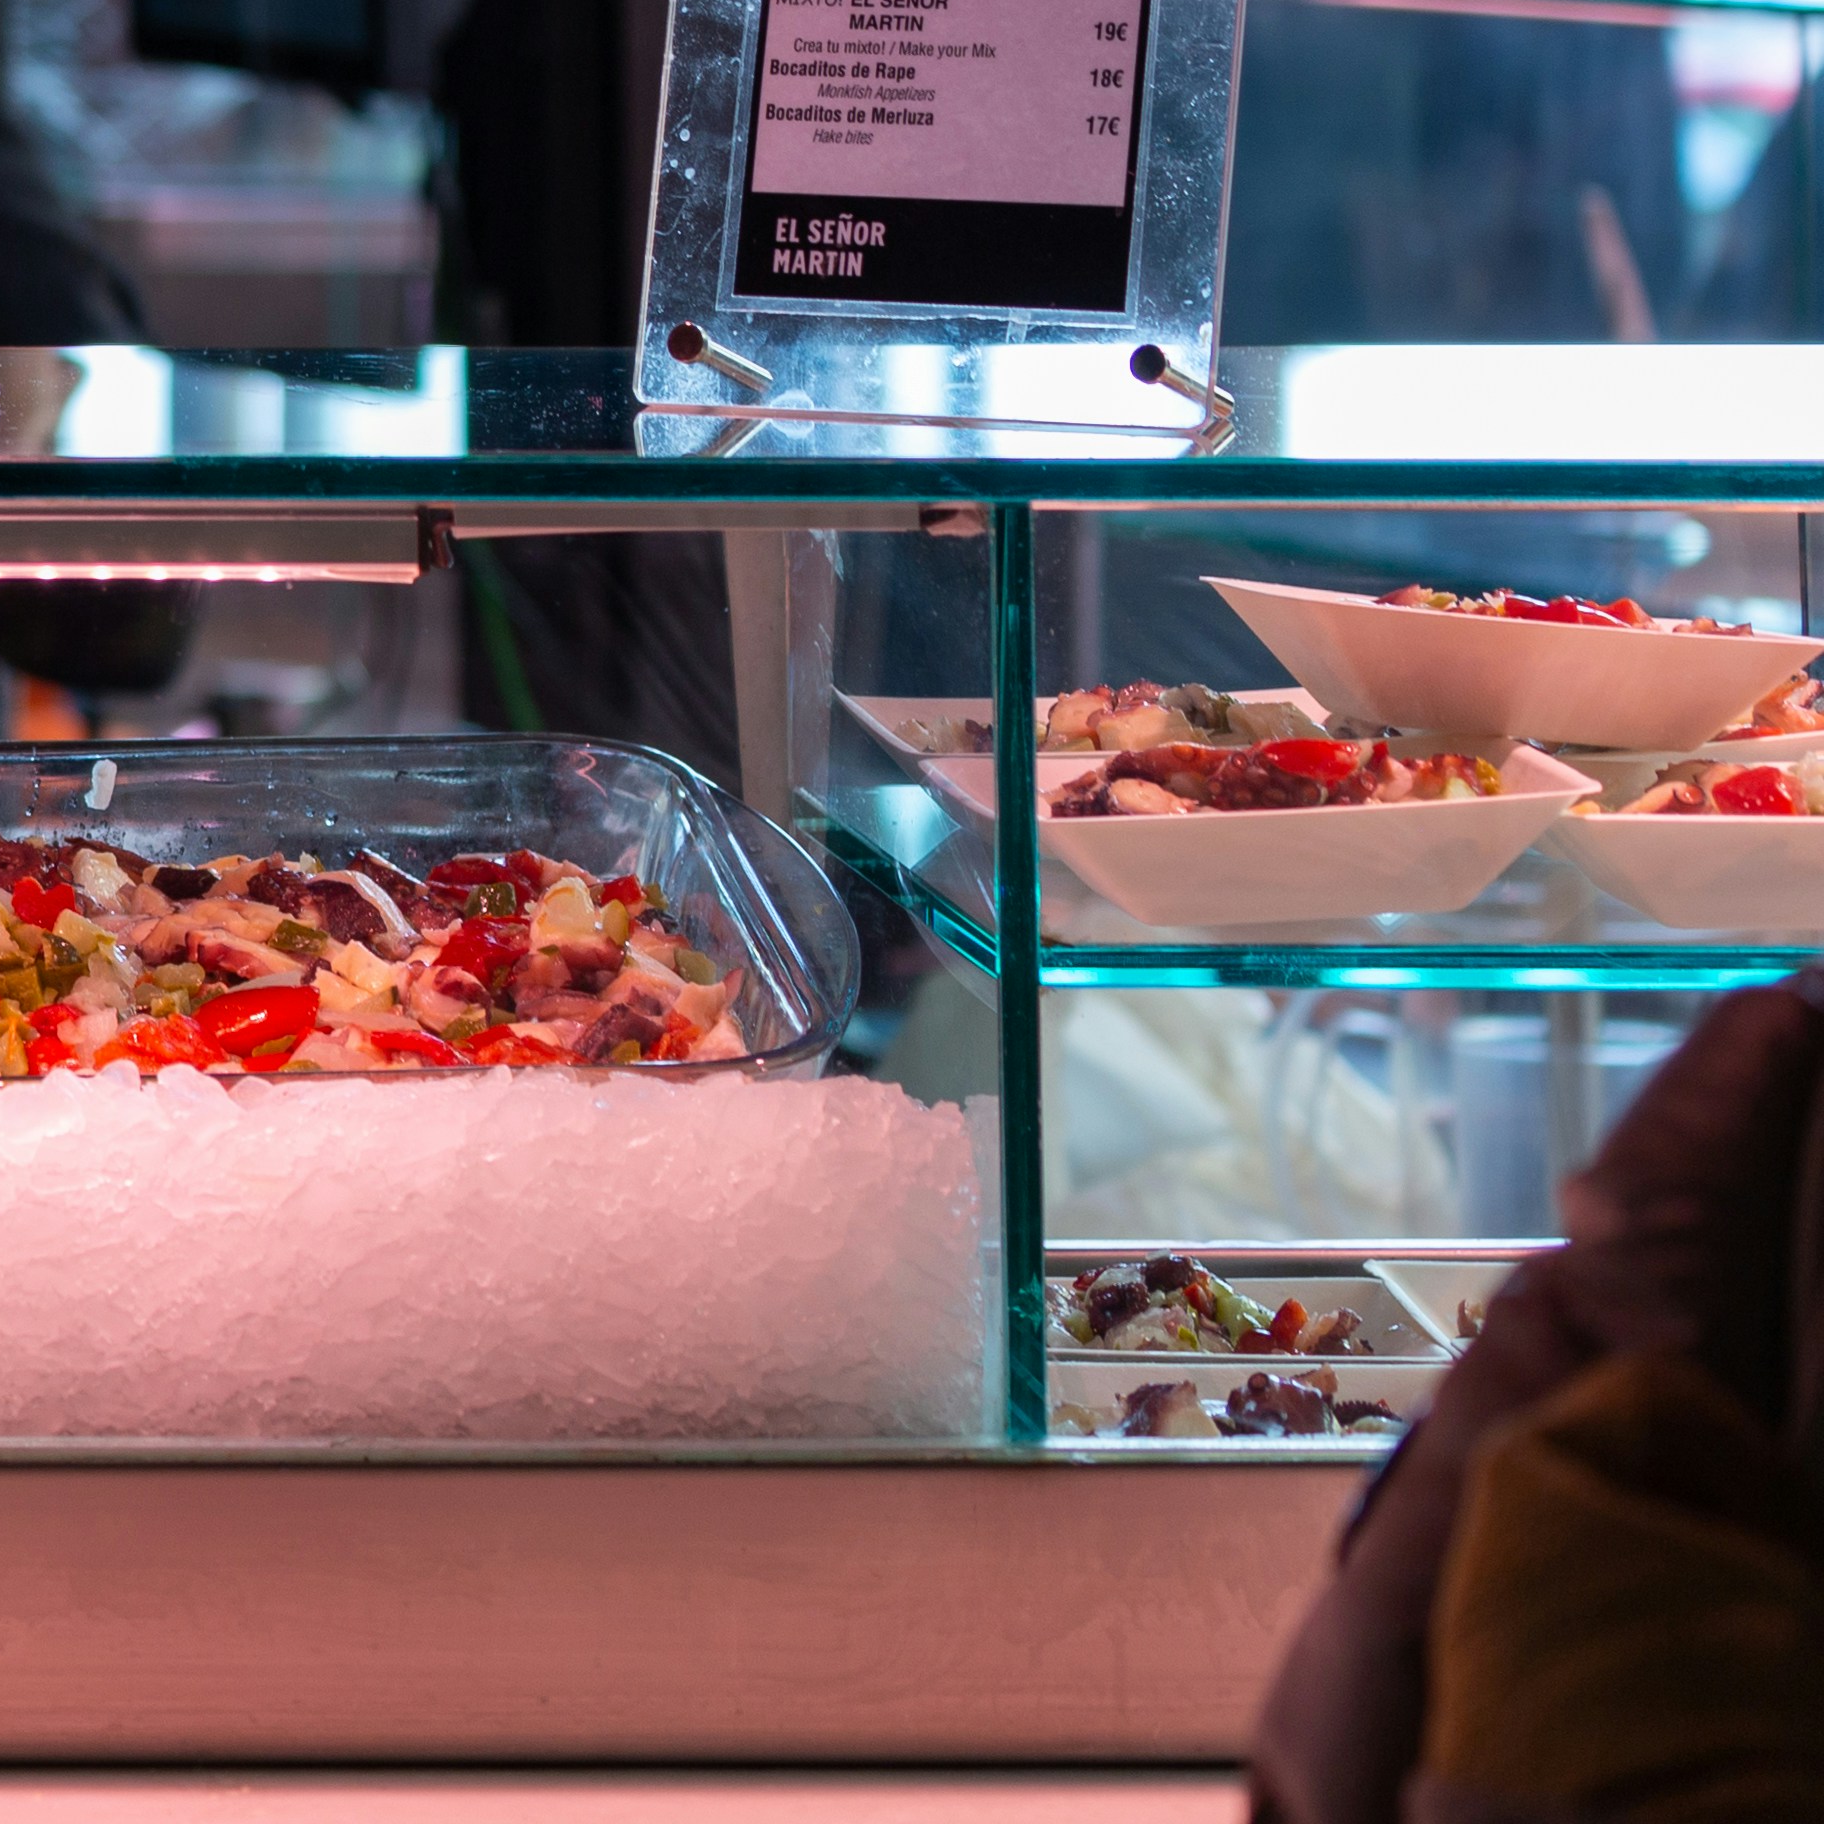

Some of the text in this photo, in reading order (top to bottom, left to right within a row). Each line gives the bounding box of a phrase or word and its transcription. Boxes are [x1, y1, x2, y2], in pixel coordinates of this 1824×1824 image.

[850, 14, 1129, 41] MARTIN 19€
[794, 38, 823, 54] Crea
[827, 40, 840, 54] tu
[843, 39, 886, 55] mixto!
[899, 41, 934, 57] Make
[937, 45, 968, 61] your
[971, 43, 996, 58] Mix
[770, 60, 1124, 88] Bocaditos de Rape 18€
[817, 83, 936, 103] Monkfish Appetizers
[765, 104, 1120, 136] Bocaditos de Merluza 17€
[813, 128, 873, 145] Hake bites
[776, 213, 886, 247] EL SEÑOR
[773, 249, 863, 276] MARTIN
